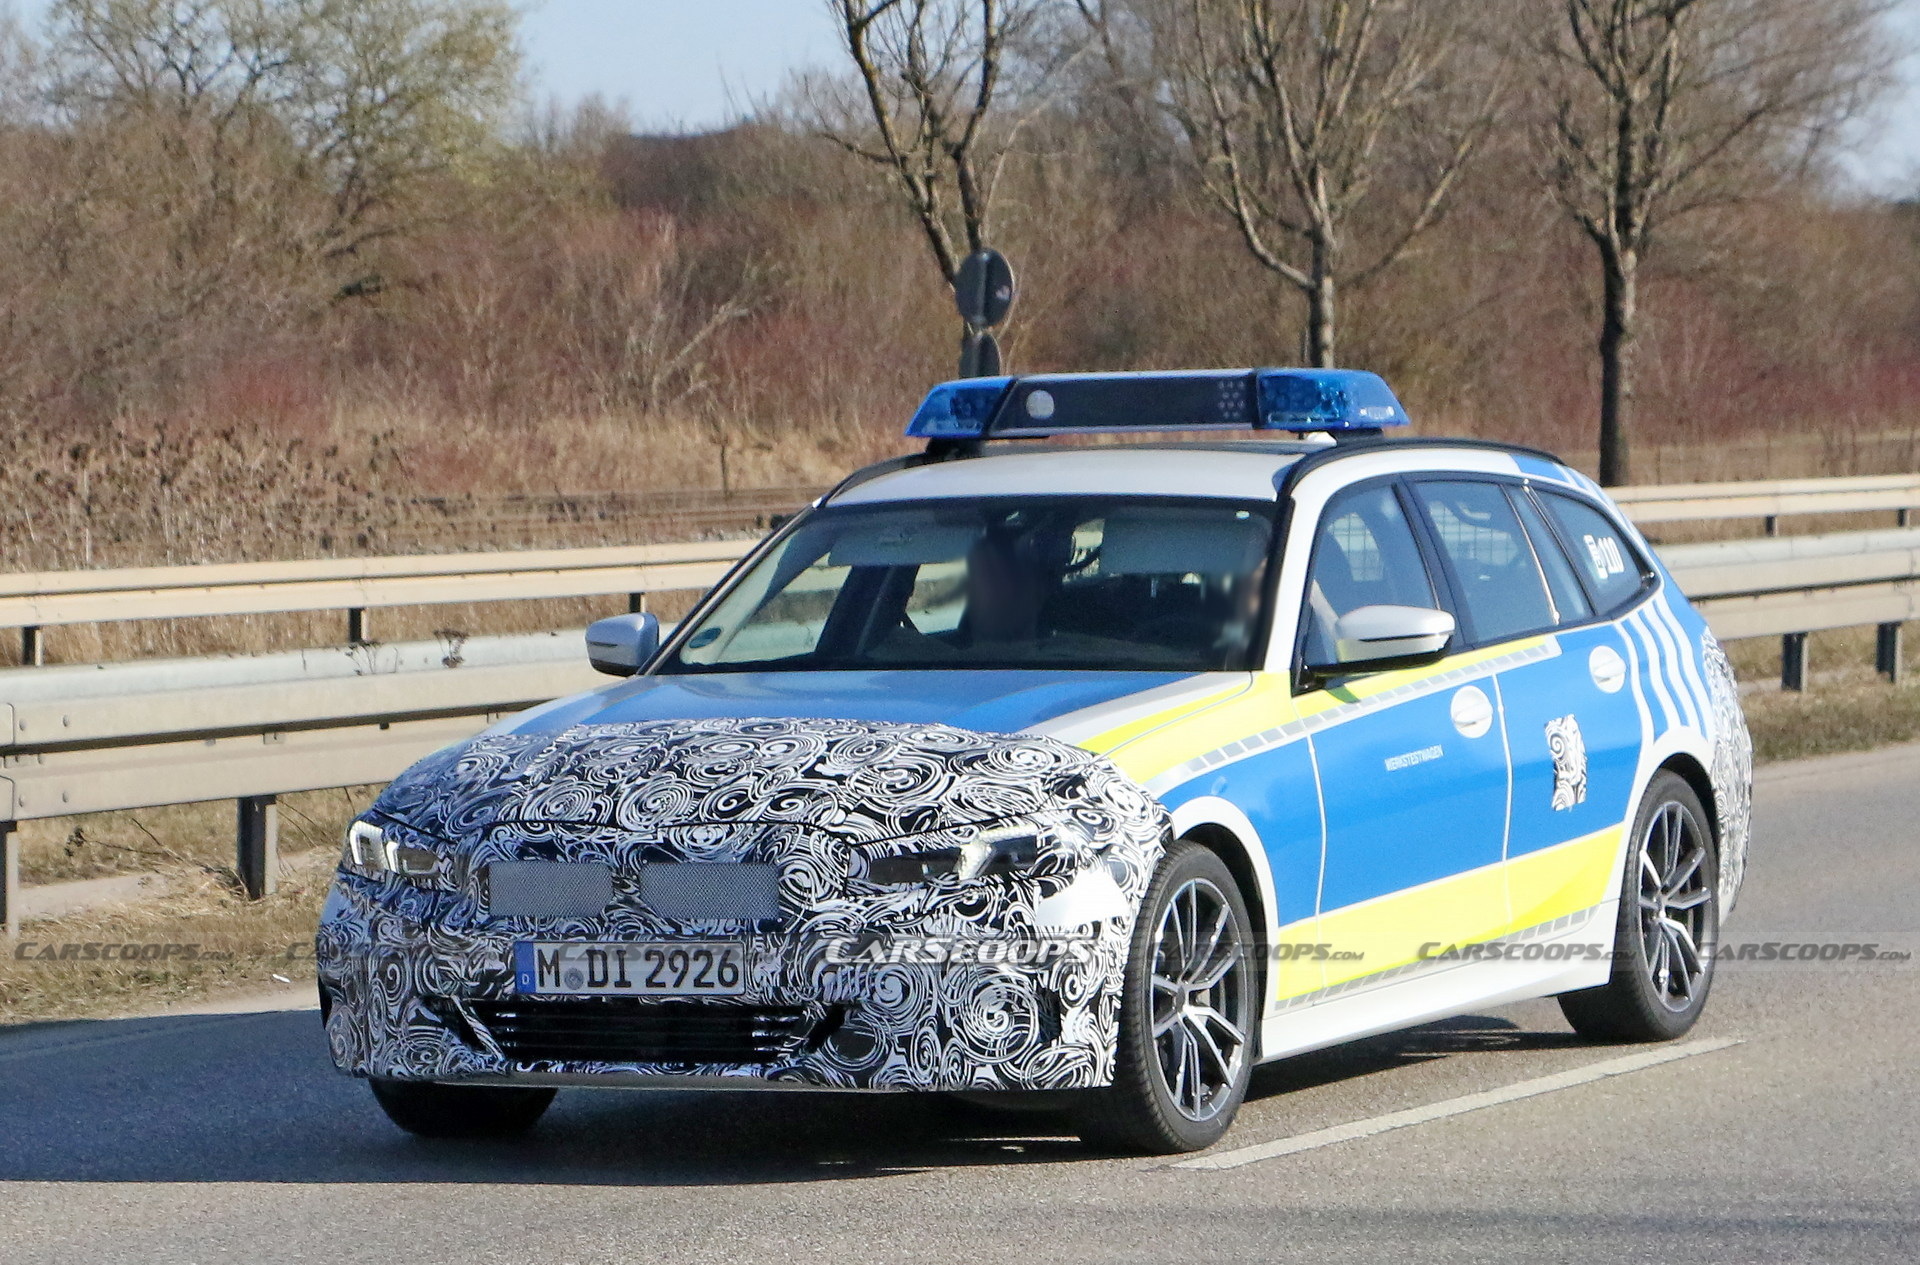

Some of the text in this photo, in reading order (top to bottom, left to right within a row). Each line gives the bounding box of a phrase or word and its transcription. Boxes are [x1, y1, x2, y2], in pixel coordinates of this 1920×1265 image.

[521, 973, 530, 985] D
[537, 949, 561, 988] M
[586, 949, 632, 988] DI
[645, 949, 739, 988] 2926
